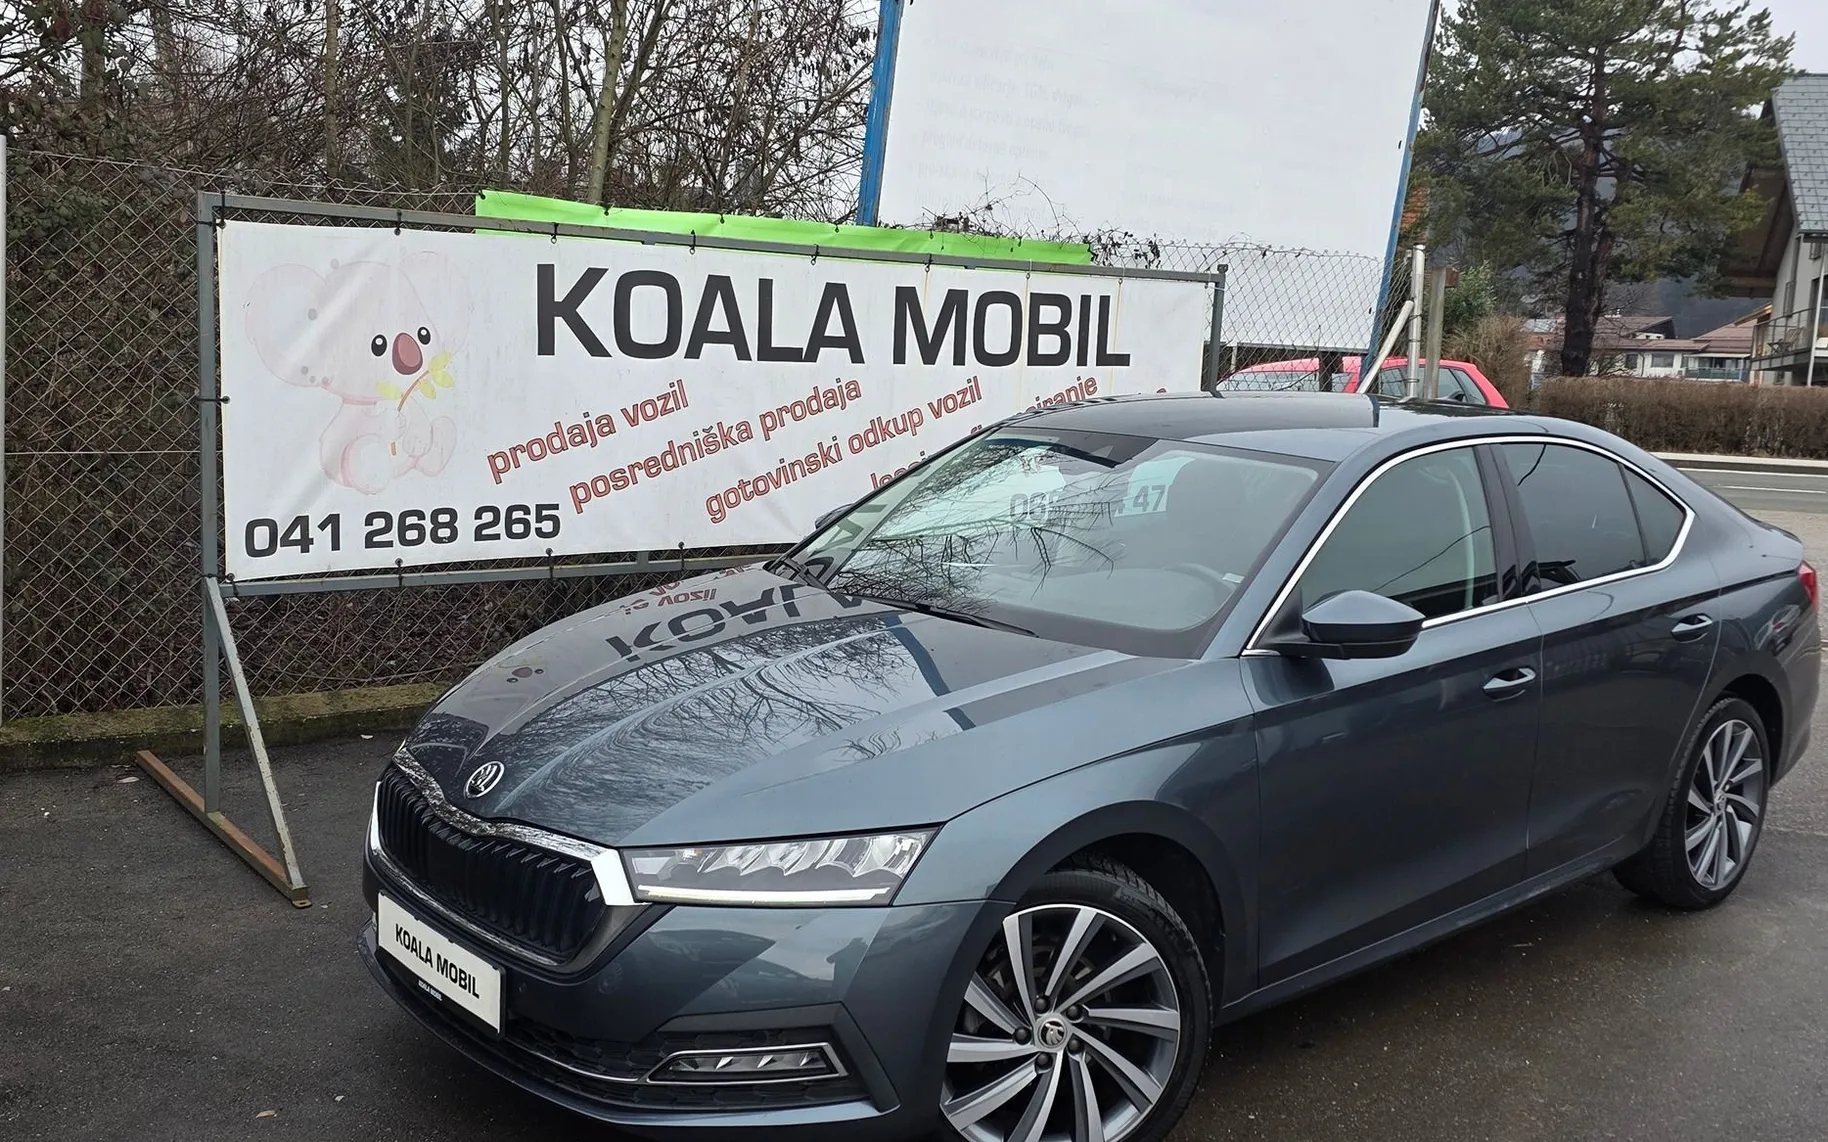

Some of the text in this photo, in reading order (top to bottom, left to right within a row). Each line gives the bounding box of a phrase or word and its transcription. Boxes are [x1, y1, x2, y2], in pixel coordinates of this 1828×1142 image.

[537, 264, 1131, 367] KOALA MOBIL
[487, 380, 689, 485] prodaja vozil
[569, 378, 862, 515] posredniška prodaja
[705, 436, 843, 524] gotovinski
[848, 407, 924, 455] odkup
[928, 376, 983, 420] vozil
[245, 503, 561, 558] 041 268 265
[395, 923, 480, 999] KOALA MOBIL
